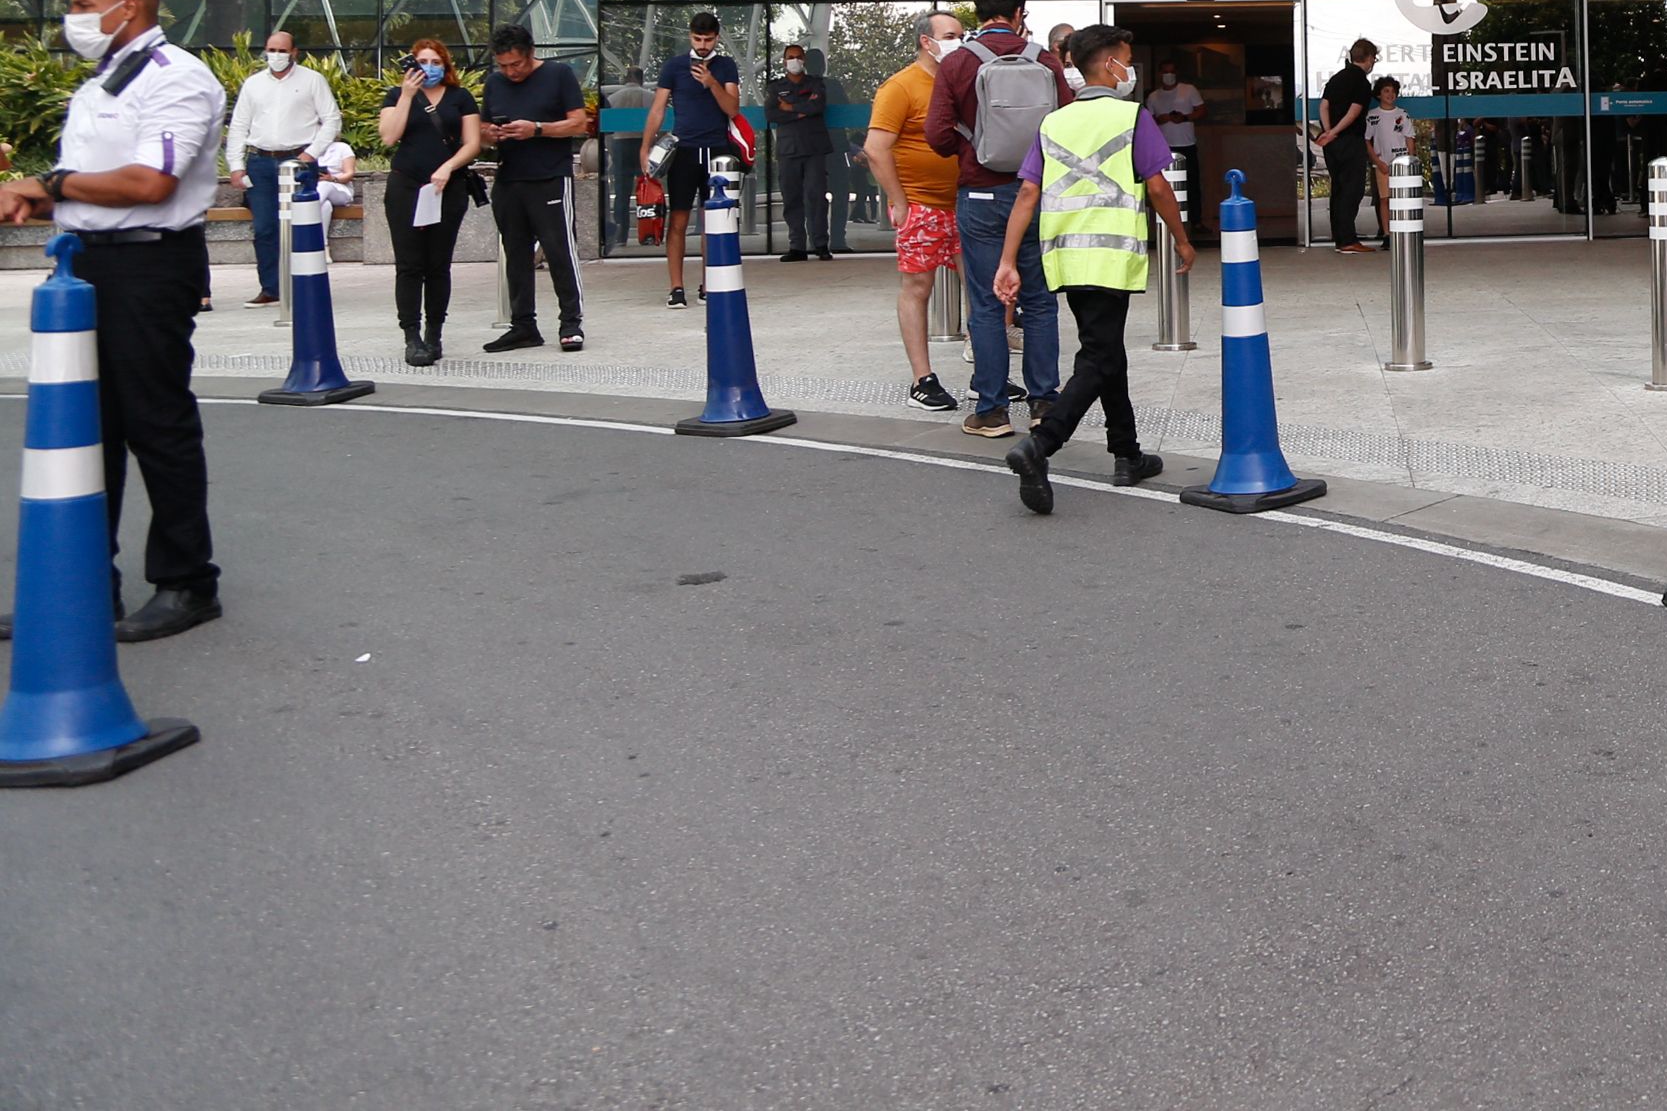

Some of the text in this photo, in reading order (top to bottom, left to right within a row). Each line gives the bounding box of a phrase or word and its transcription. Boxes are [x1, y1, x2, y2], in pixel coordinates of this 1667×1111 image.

[1337, 42, 1555, 64] ABERT EINSTEIN
[1447, 67, 1577, 91] ISRAELITA
